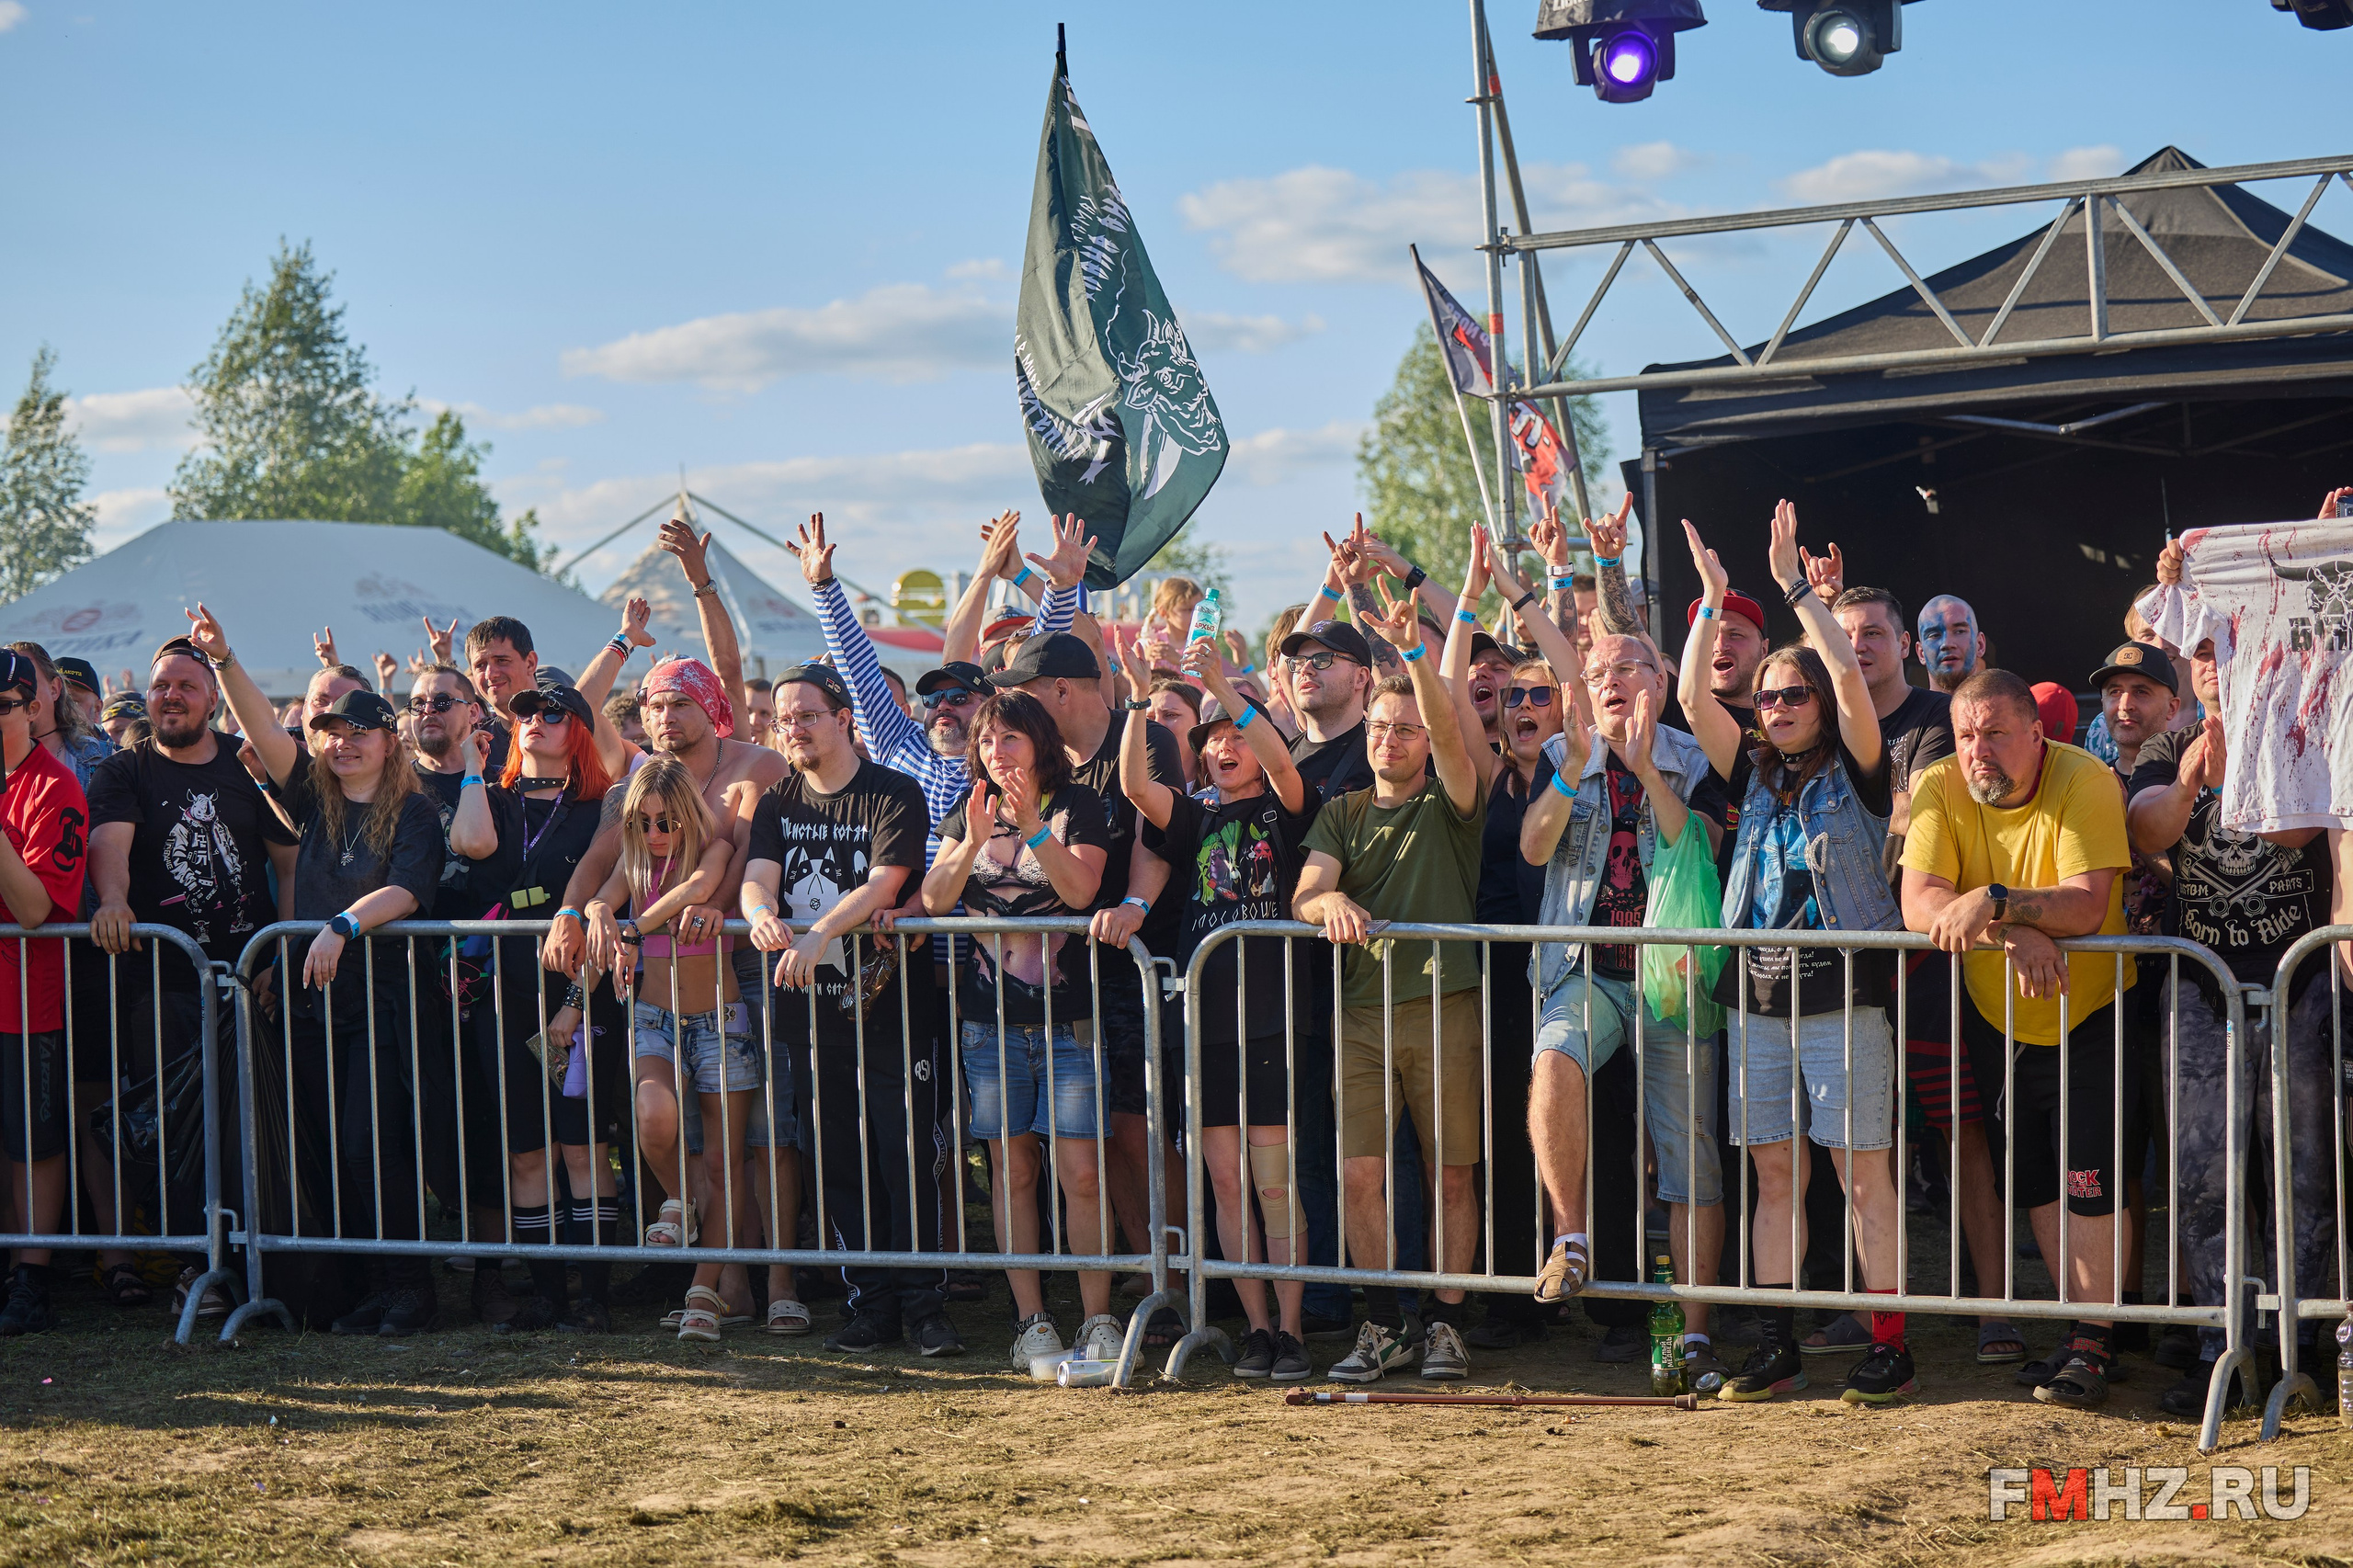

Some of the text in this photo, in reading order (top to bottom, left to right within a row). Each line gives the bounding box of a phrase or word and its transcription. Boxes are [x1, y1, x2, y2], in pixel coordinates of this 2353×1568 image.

[1194, 622, 1216, 632] АРХЫЗ
[2268, 876, 2303, 894] PARTS
[2184, 904, 2302, 948] Born to Ride
